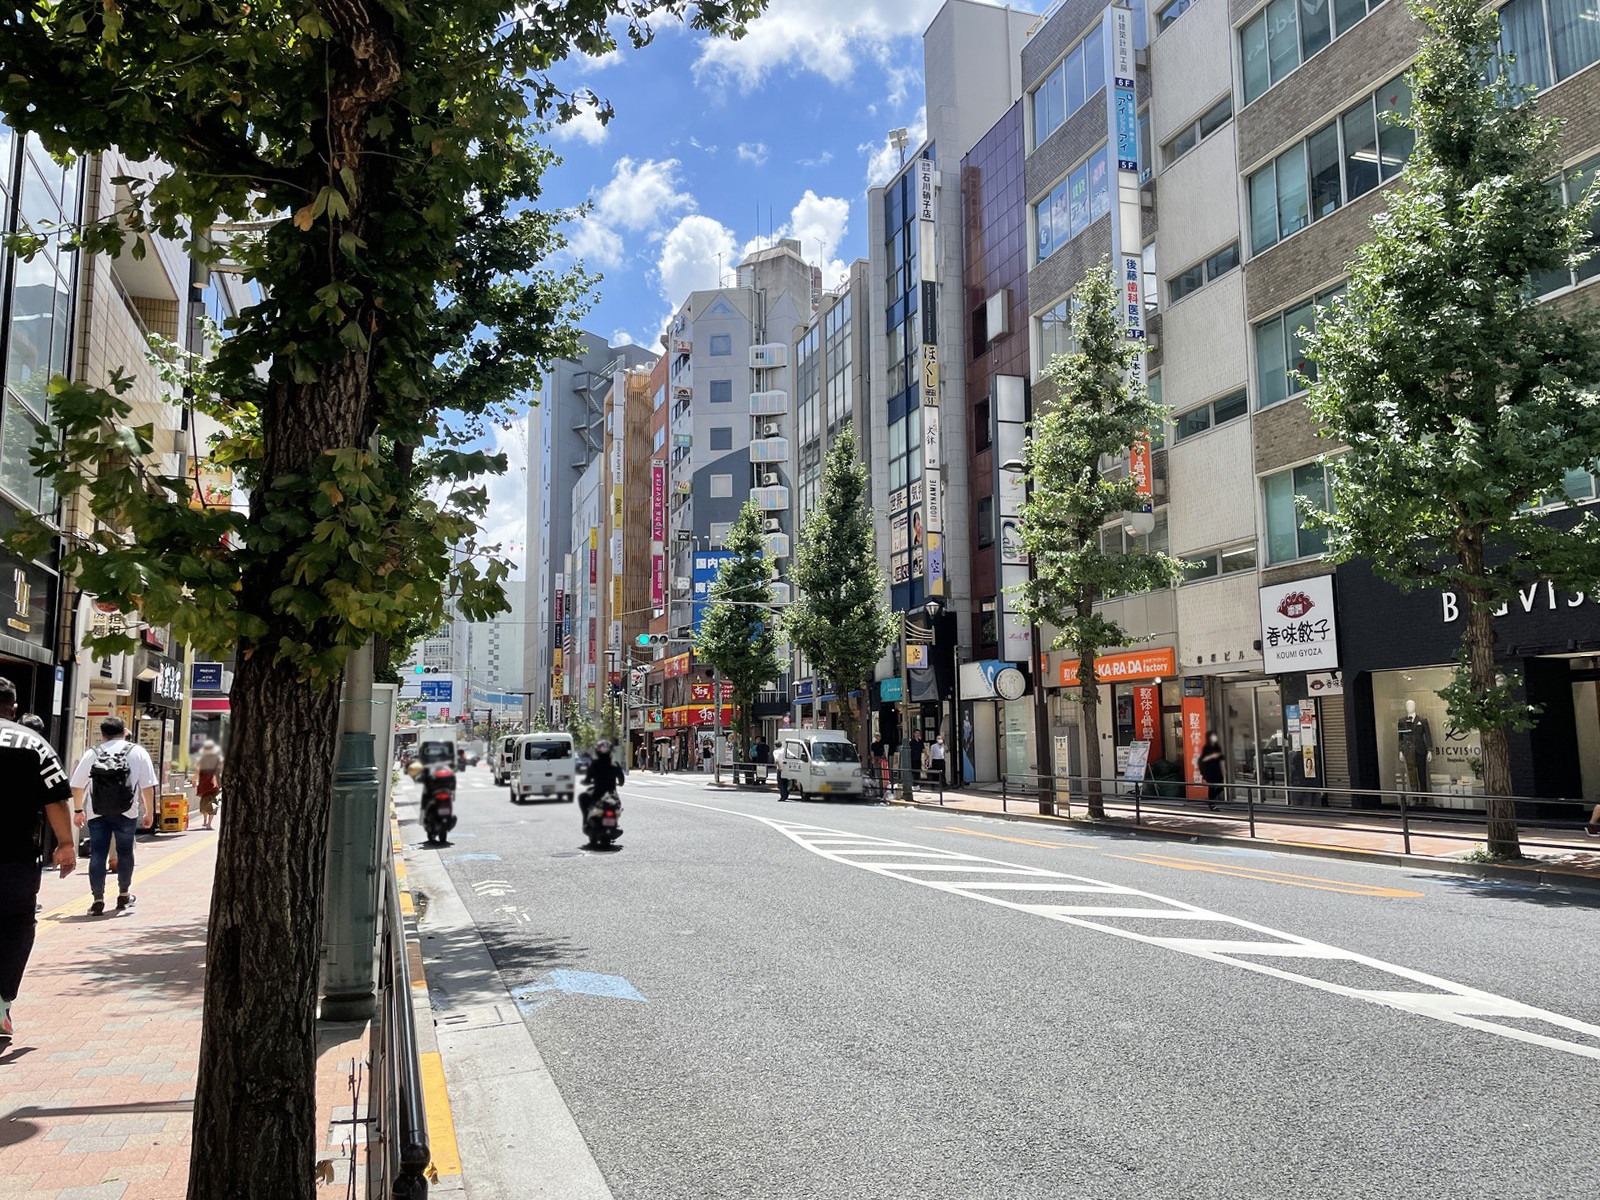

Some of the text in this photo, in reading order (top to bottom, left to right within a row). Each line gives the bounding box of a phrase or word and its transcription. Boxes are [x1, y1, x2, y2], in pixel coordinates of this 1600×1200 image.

[1121, 161, 1133, 169] 5F
[922, 172, 931, 219] 石川硝子店
[1126, 258, 1139, 327] 後藤歯科医院
[924, 346, 936, 388] ほぐし
[930, 558, 940, 574] 空
[1266, 619, 1331, 647] 香味餃子
[1276, 647, 1323, 660] KOUMI GYOZA
[1143, 662, 1168, 673] factory
